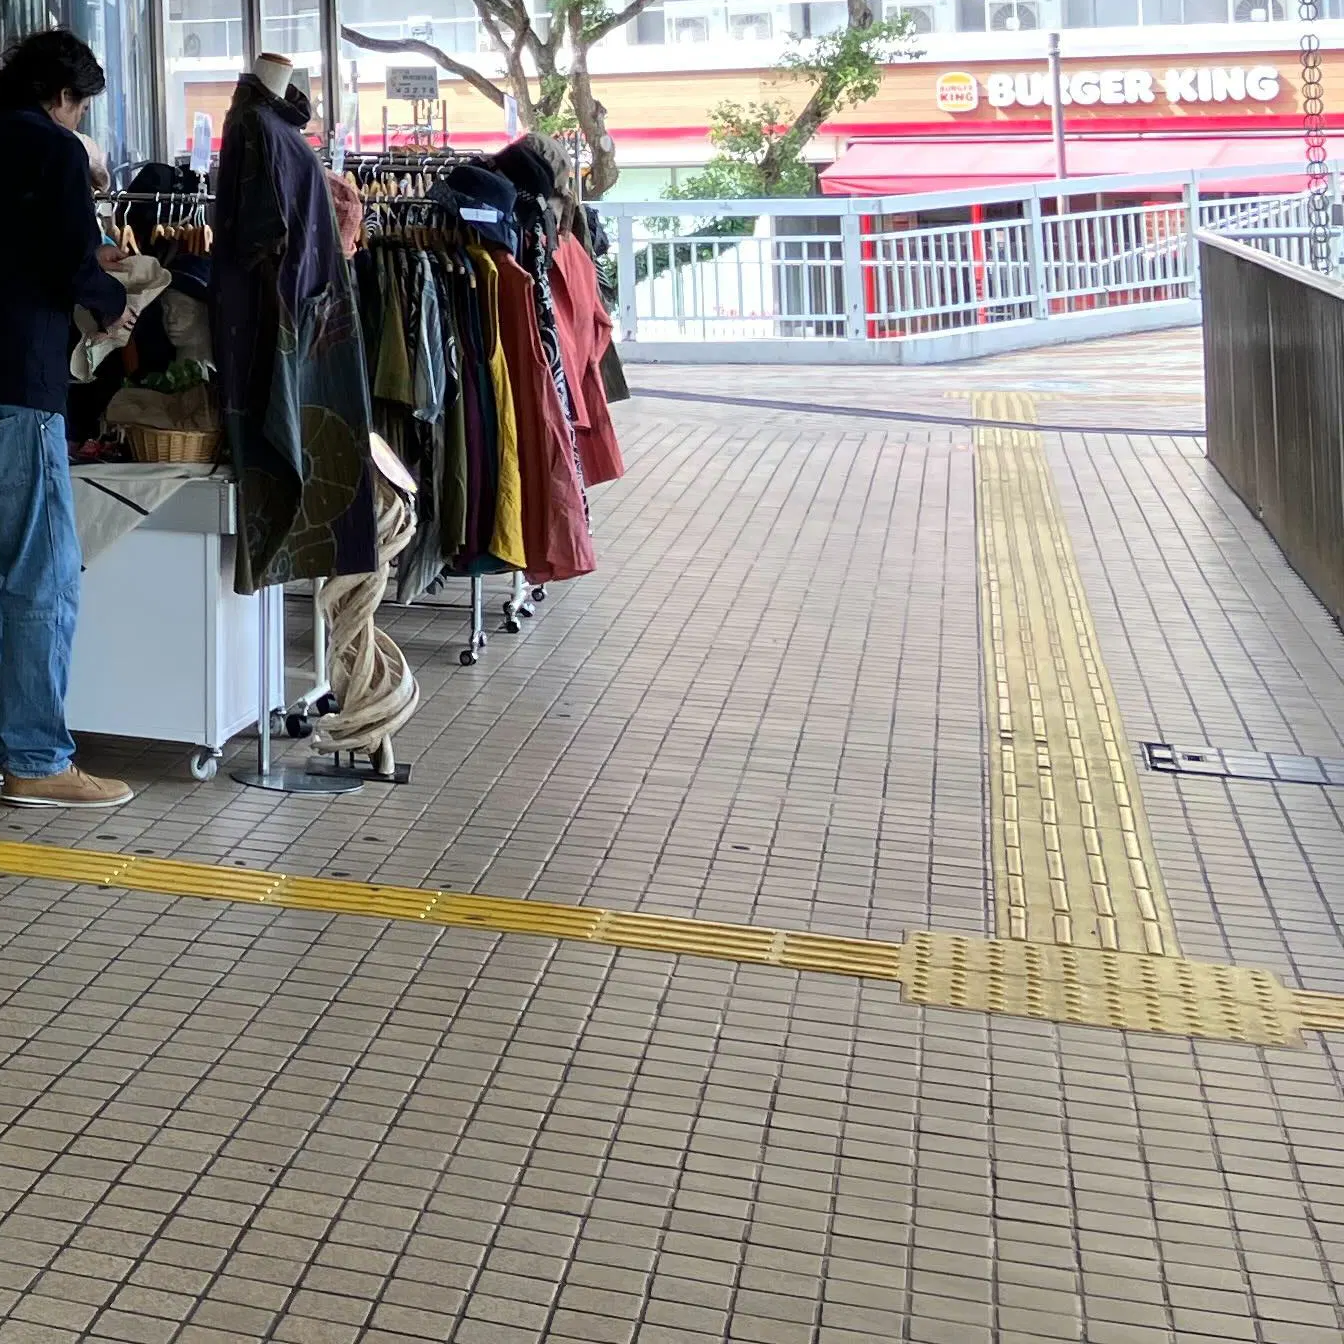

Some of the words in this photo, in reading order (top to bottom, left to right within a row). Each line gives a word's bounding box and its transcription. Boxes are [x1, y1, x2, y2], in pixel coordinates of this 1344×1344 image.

[939, 84, 974, 94] BURGER
[987, 68, 1155, 106] BURGER
[1165, 64, 1280, 103] KING
[940, 93, 974, 103] KING
